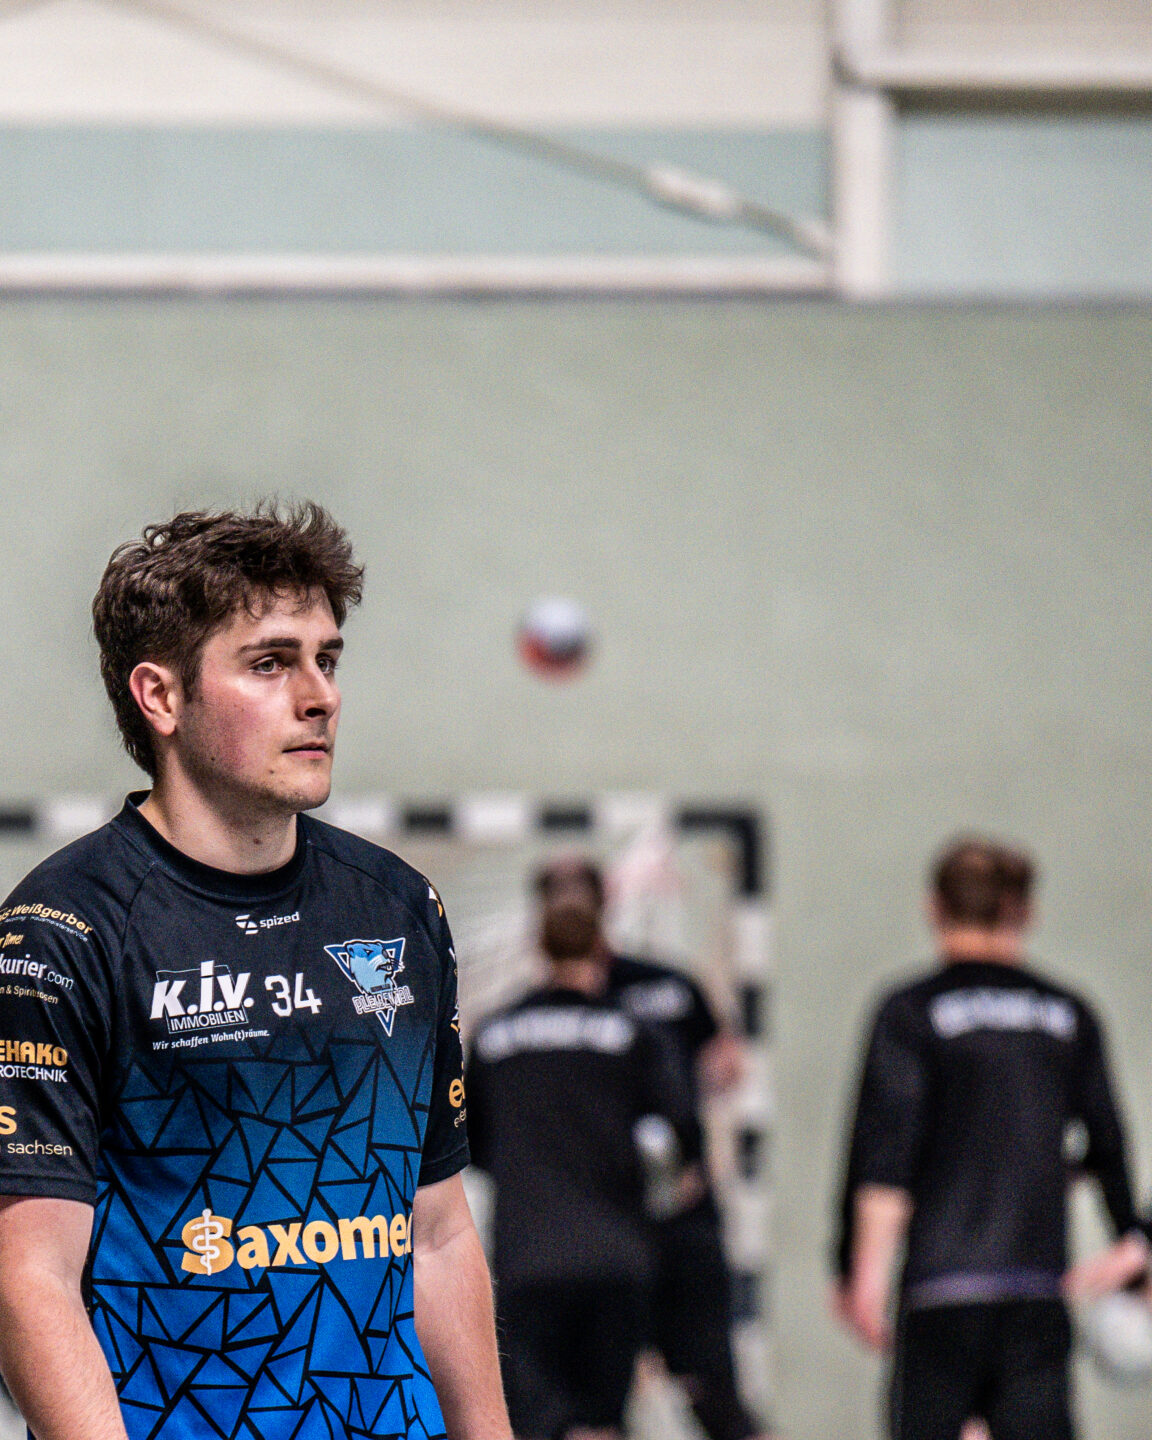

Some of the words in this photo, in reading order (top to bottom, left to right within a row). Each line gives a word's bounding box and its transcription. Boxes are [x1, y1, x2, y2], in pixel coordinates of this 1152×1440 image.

[11, 903, 93, 934] Weißgerber
[259, 911, 300, 929] spized
[6, 984, 12, 995] &
[264, 972, 323, 1018] 34
[170, 1010, 246, 1032] IMMOBILIEN
[152, 1041, 169, 1051] Wir
[171, 1036, 209, 1048] schaffen
[210, 1029, 270, 1042] Wohn(t)räume.
[7, 1139, 73, 1157] sachsen
